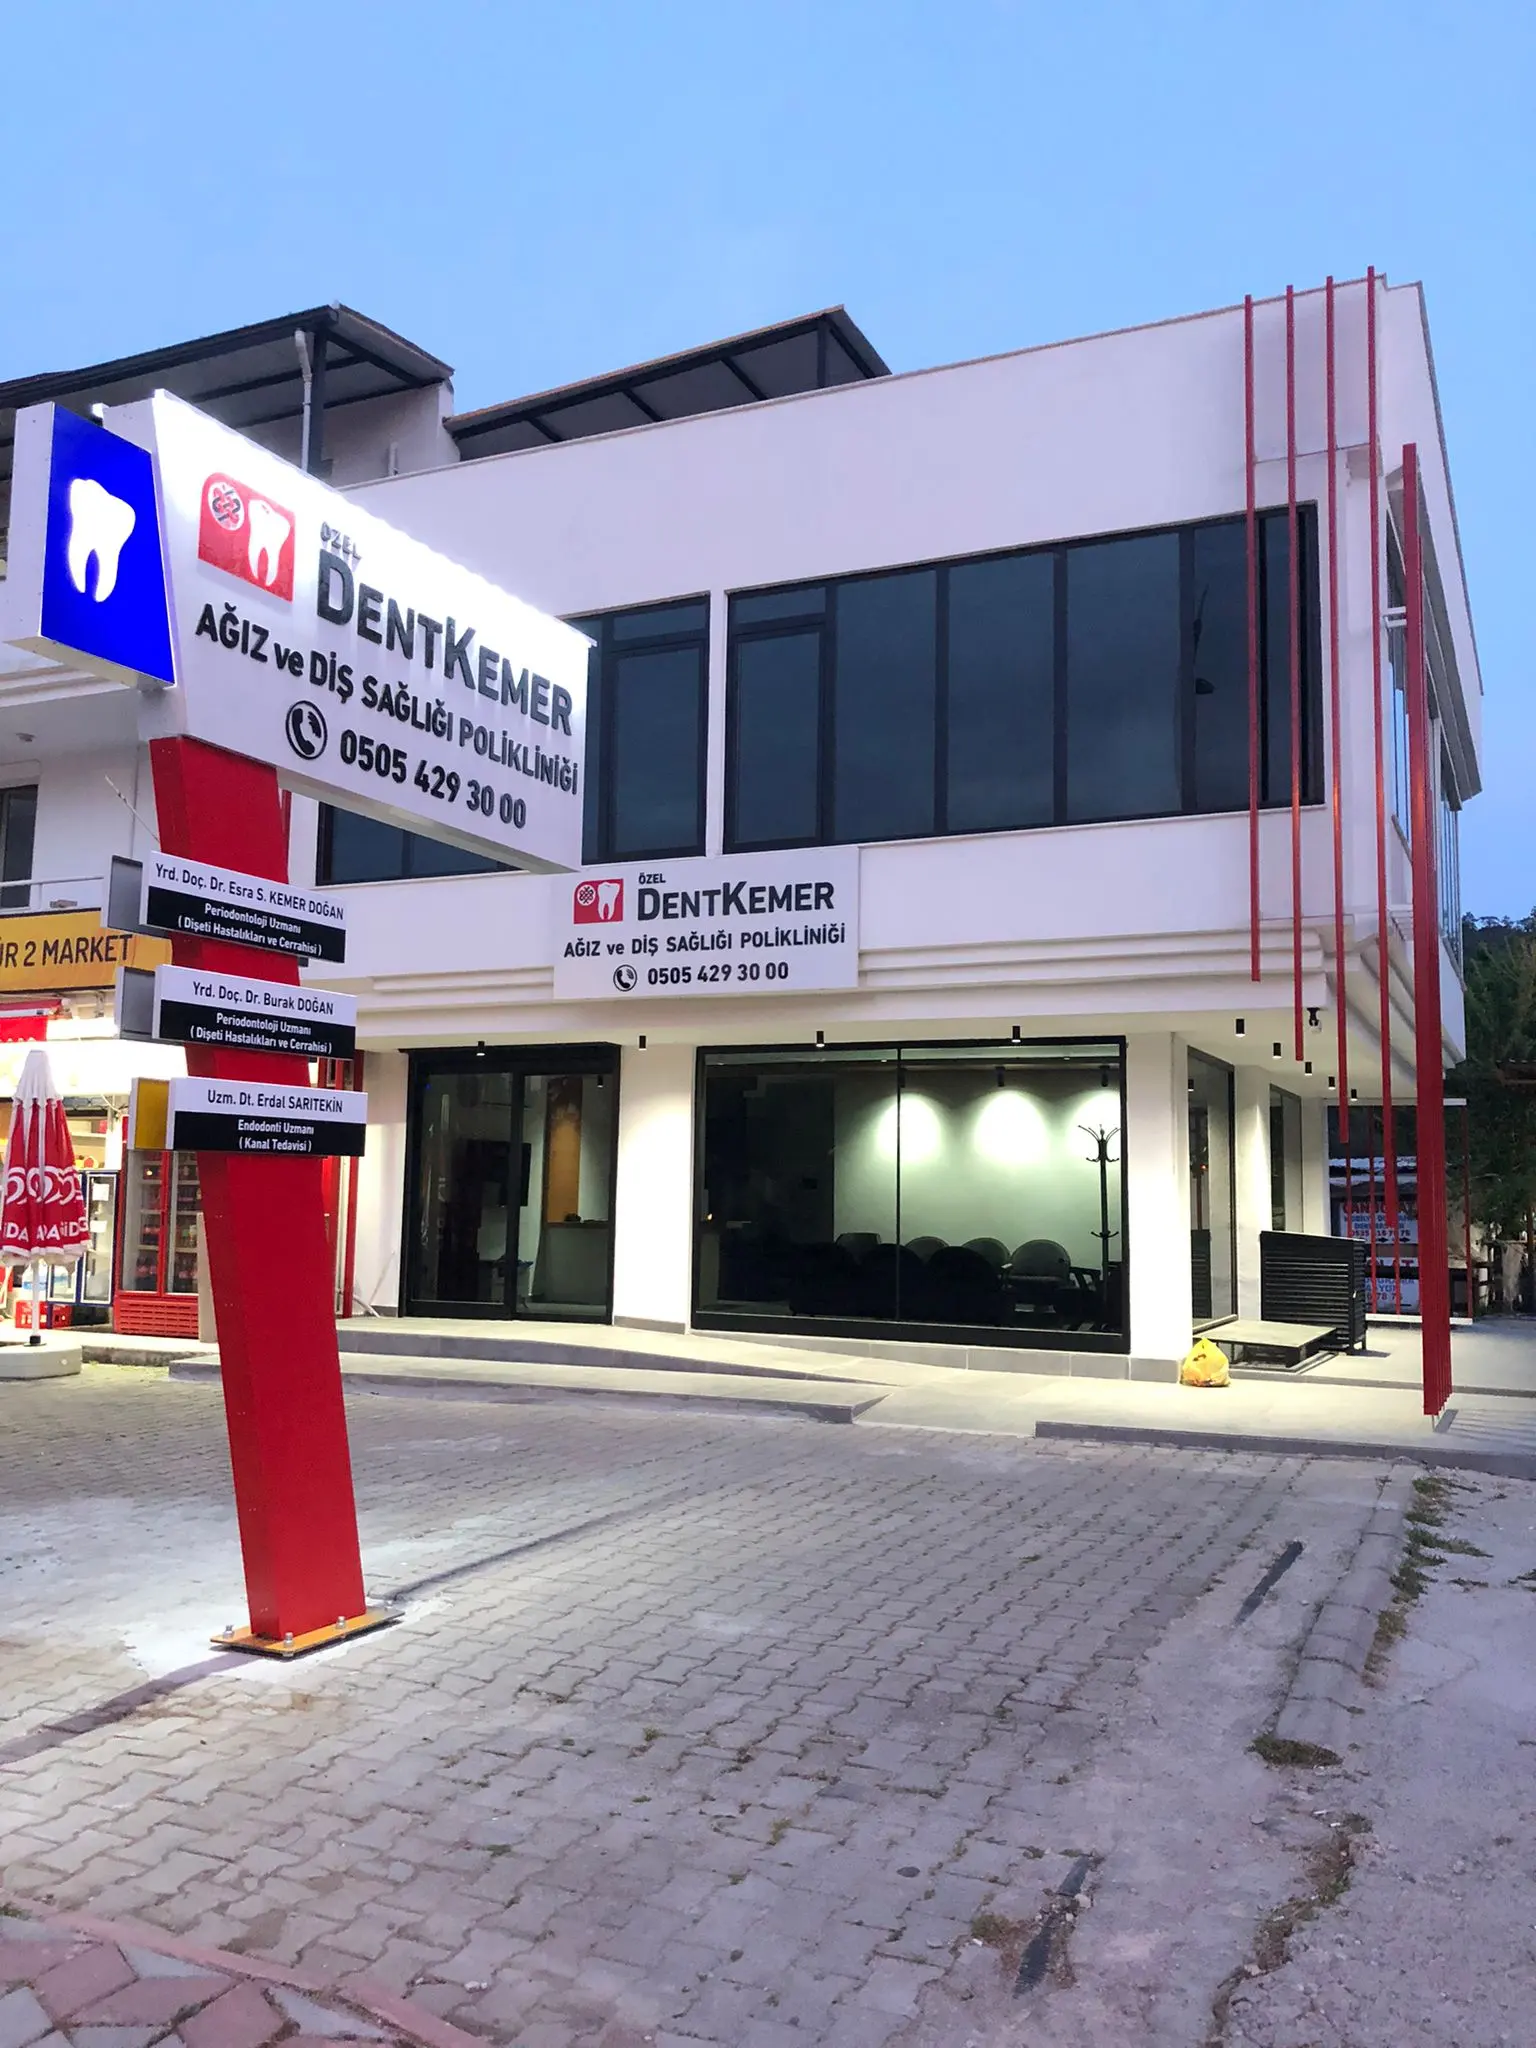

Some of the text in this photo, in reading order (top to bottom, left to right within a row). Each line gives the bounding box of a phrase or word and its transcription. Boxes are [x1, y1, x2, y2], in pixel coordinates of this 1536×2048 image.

[316, 548, 573, 736] DENTKEMER
[195, 602, 578, 796] AĞIZ ve DİŞ SAĞLIĞI POLİKLİNİĞİ
[340, 730, 527, 829] 0505 429 30 00
[156, 863, 344, 920] Yrd. Doç. Dr. Esra S. KEMER DOĞAN
[638, 873, 666, 885] ÖZEL
[637, 881, 834, 921] DENTKEMER
[204, 903, 301, 934] Periodontoloji Uzmanı
[23, 941, 37, 967] 2
[42, 934, 132, 966] MARKET
[213, 923, 266, 945] Hastalıkları
[267, 936, 278, 947] ve
[564, 923, 845, 958] AĞIZ ve DİŞ SAĞLIĞI POLİKLİNİĞİ
[648, 962, 789, 985] 0505 429 30 00
[193, 981, 334, 1015] Yrd. Doç. Dr. Burak DOĞAN
[216, 1012, 311, 1036] Periodontoloji Uzmanı
[225, 1030, 277, 1047] Hastalıkları
[278, 1039, 289, 1049] ve
[207, 1089, 343, 1113] Uzm. Dt. Erdal SARITEKİN
[238, 1118, 314, 1135] Endodonti Uzmanı
